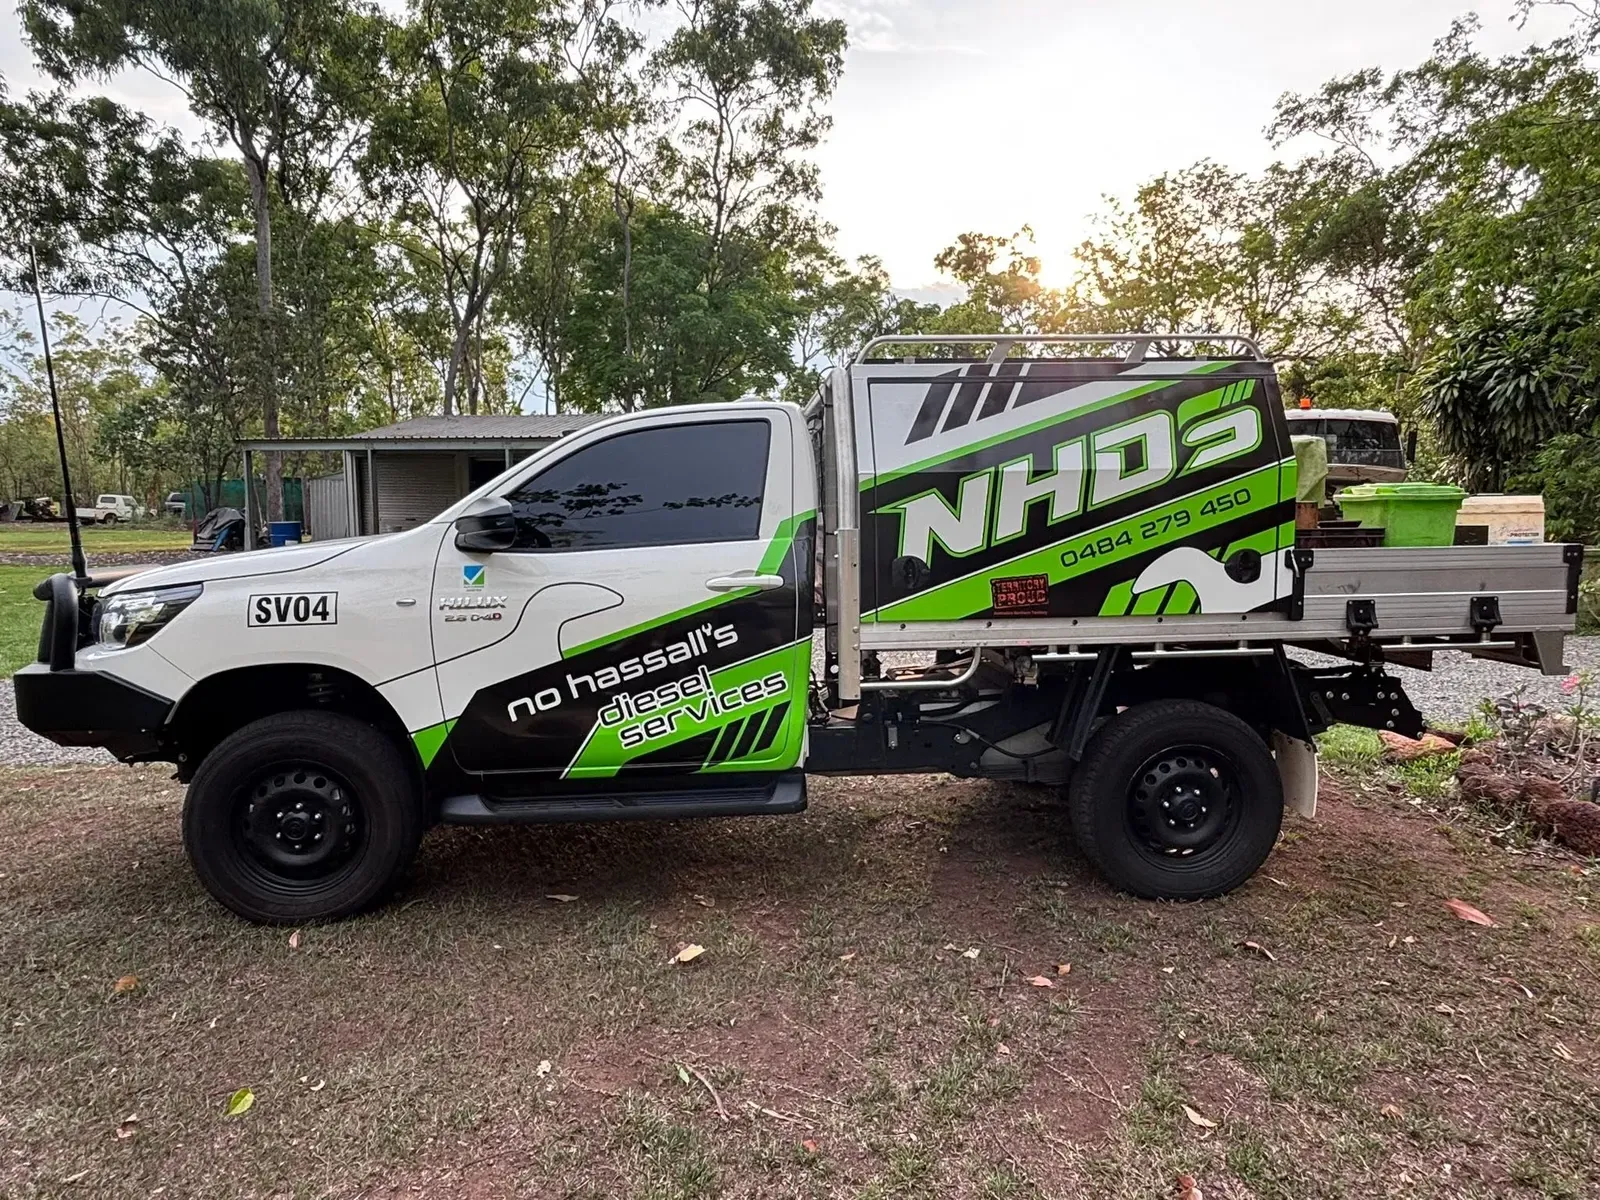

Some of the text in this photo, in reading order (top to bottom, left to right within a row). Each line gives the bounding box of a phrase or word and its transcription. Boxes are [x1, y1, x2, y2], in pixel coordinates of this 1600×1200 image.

[868, 379, 1263, 568] NHDS
[1060, 488, 1251, 567] 0484 279 450
[254, 595, 329, 624] SV04
[439, 596, 508, 610] HILUX
[995, 578, 1045, 592] TERRITORY
[997, 590, 1046, 606] PROUD
[506, 622, 739, 722] no hassall's
[598, 665, 714, 728] diesel
[618, 671, 788, 749] services
